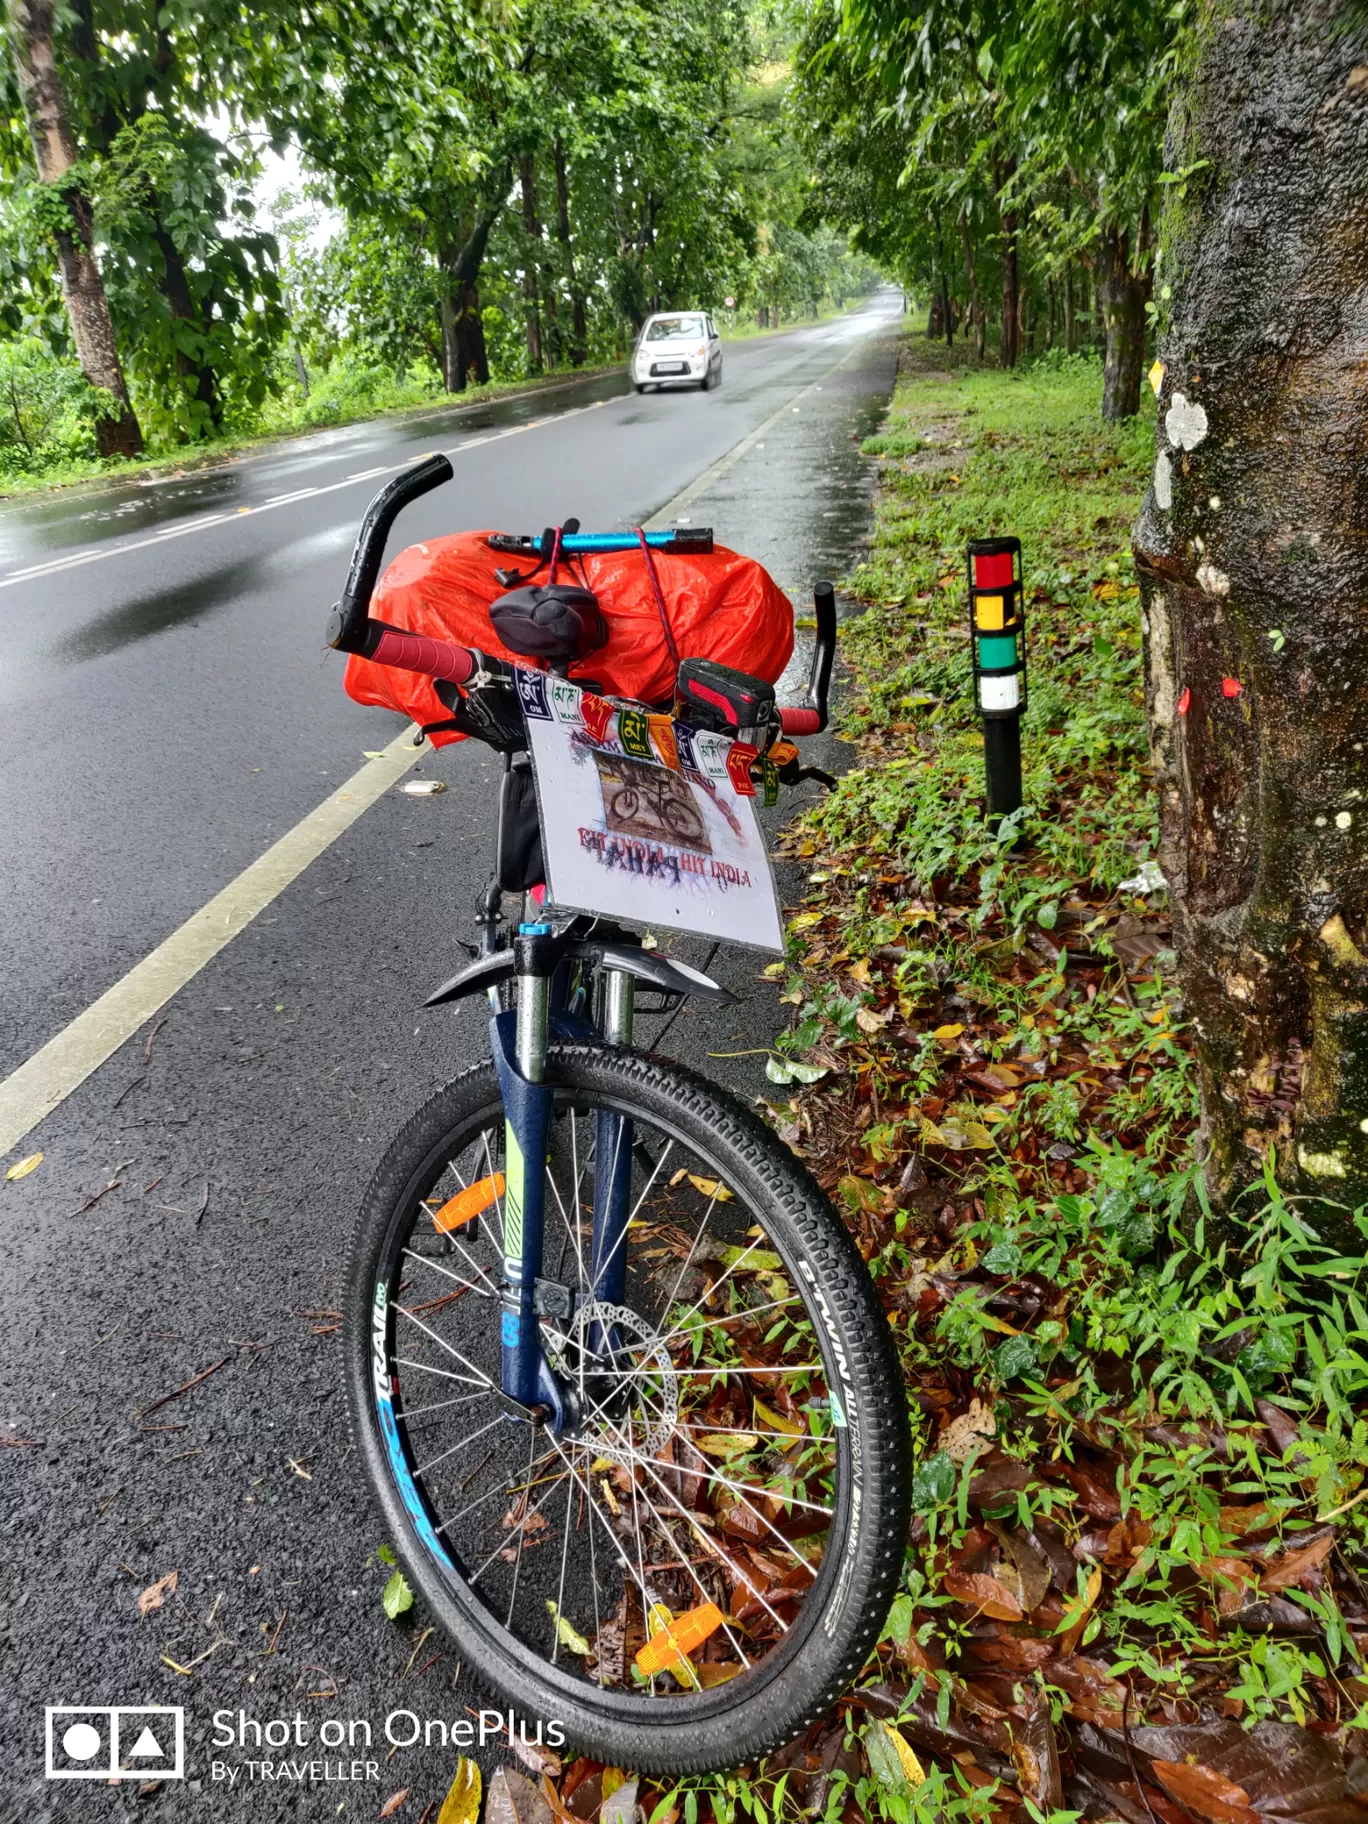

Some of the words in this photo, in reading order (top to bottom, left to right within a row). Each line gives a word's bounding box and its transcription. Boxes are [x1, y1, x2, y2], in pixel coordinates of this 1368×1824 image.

[529, 704, 544, 714] OM
[560, 711, 580, 721] MANI
[630, 742, 646, 752] MEY
[708, 766, 724, 775] MANI
[577, 827, 608, 851] FIT
[613, 837, 665, 864] INDIA
[680, 852, 706, 876] HIT
[710, 860, 752, 888] INDIA
[376, 1282, 386, 1305] EVO
